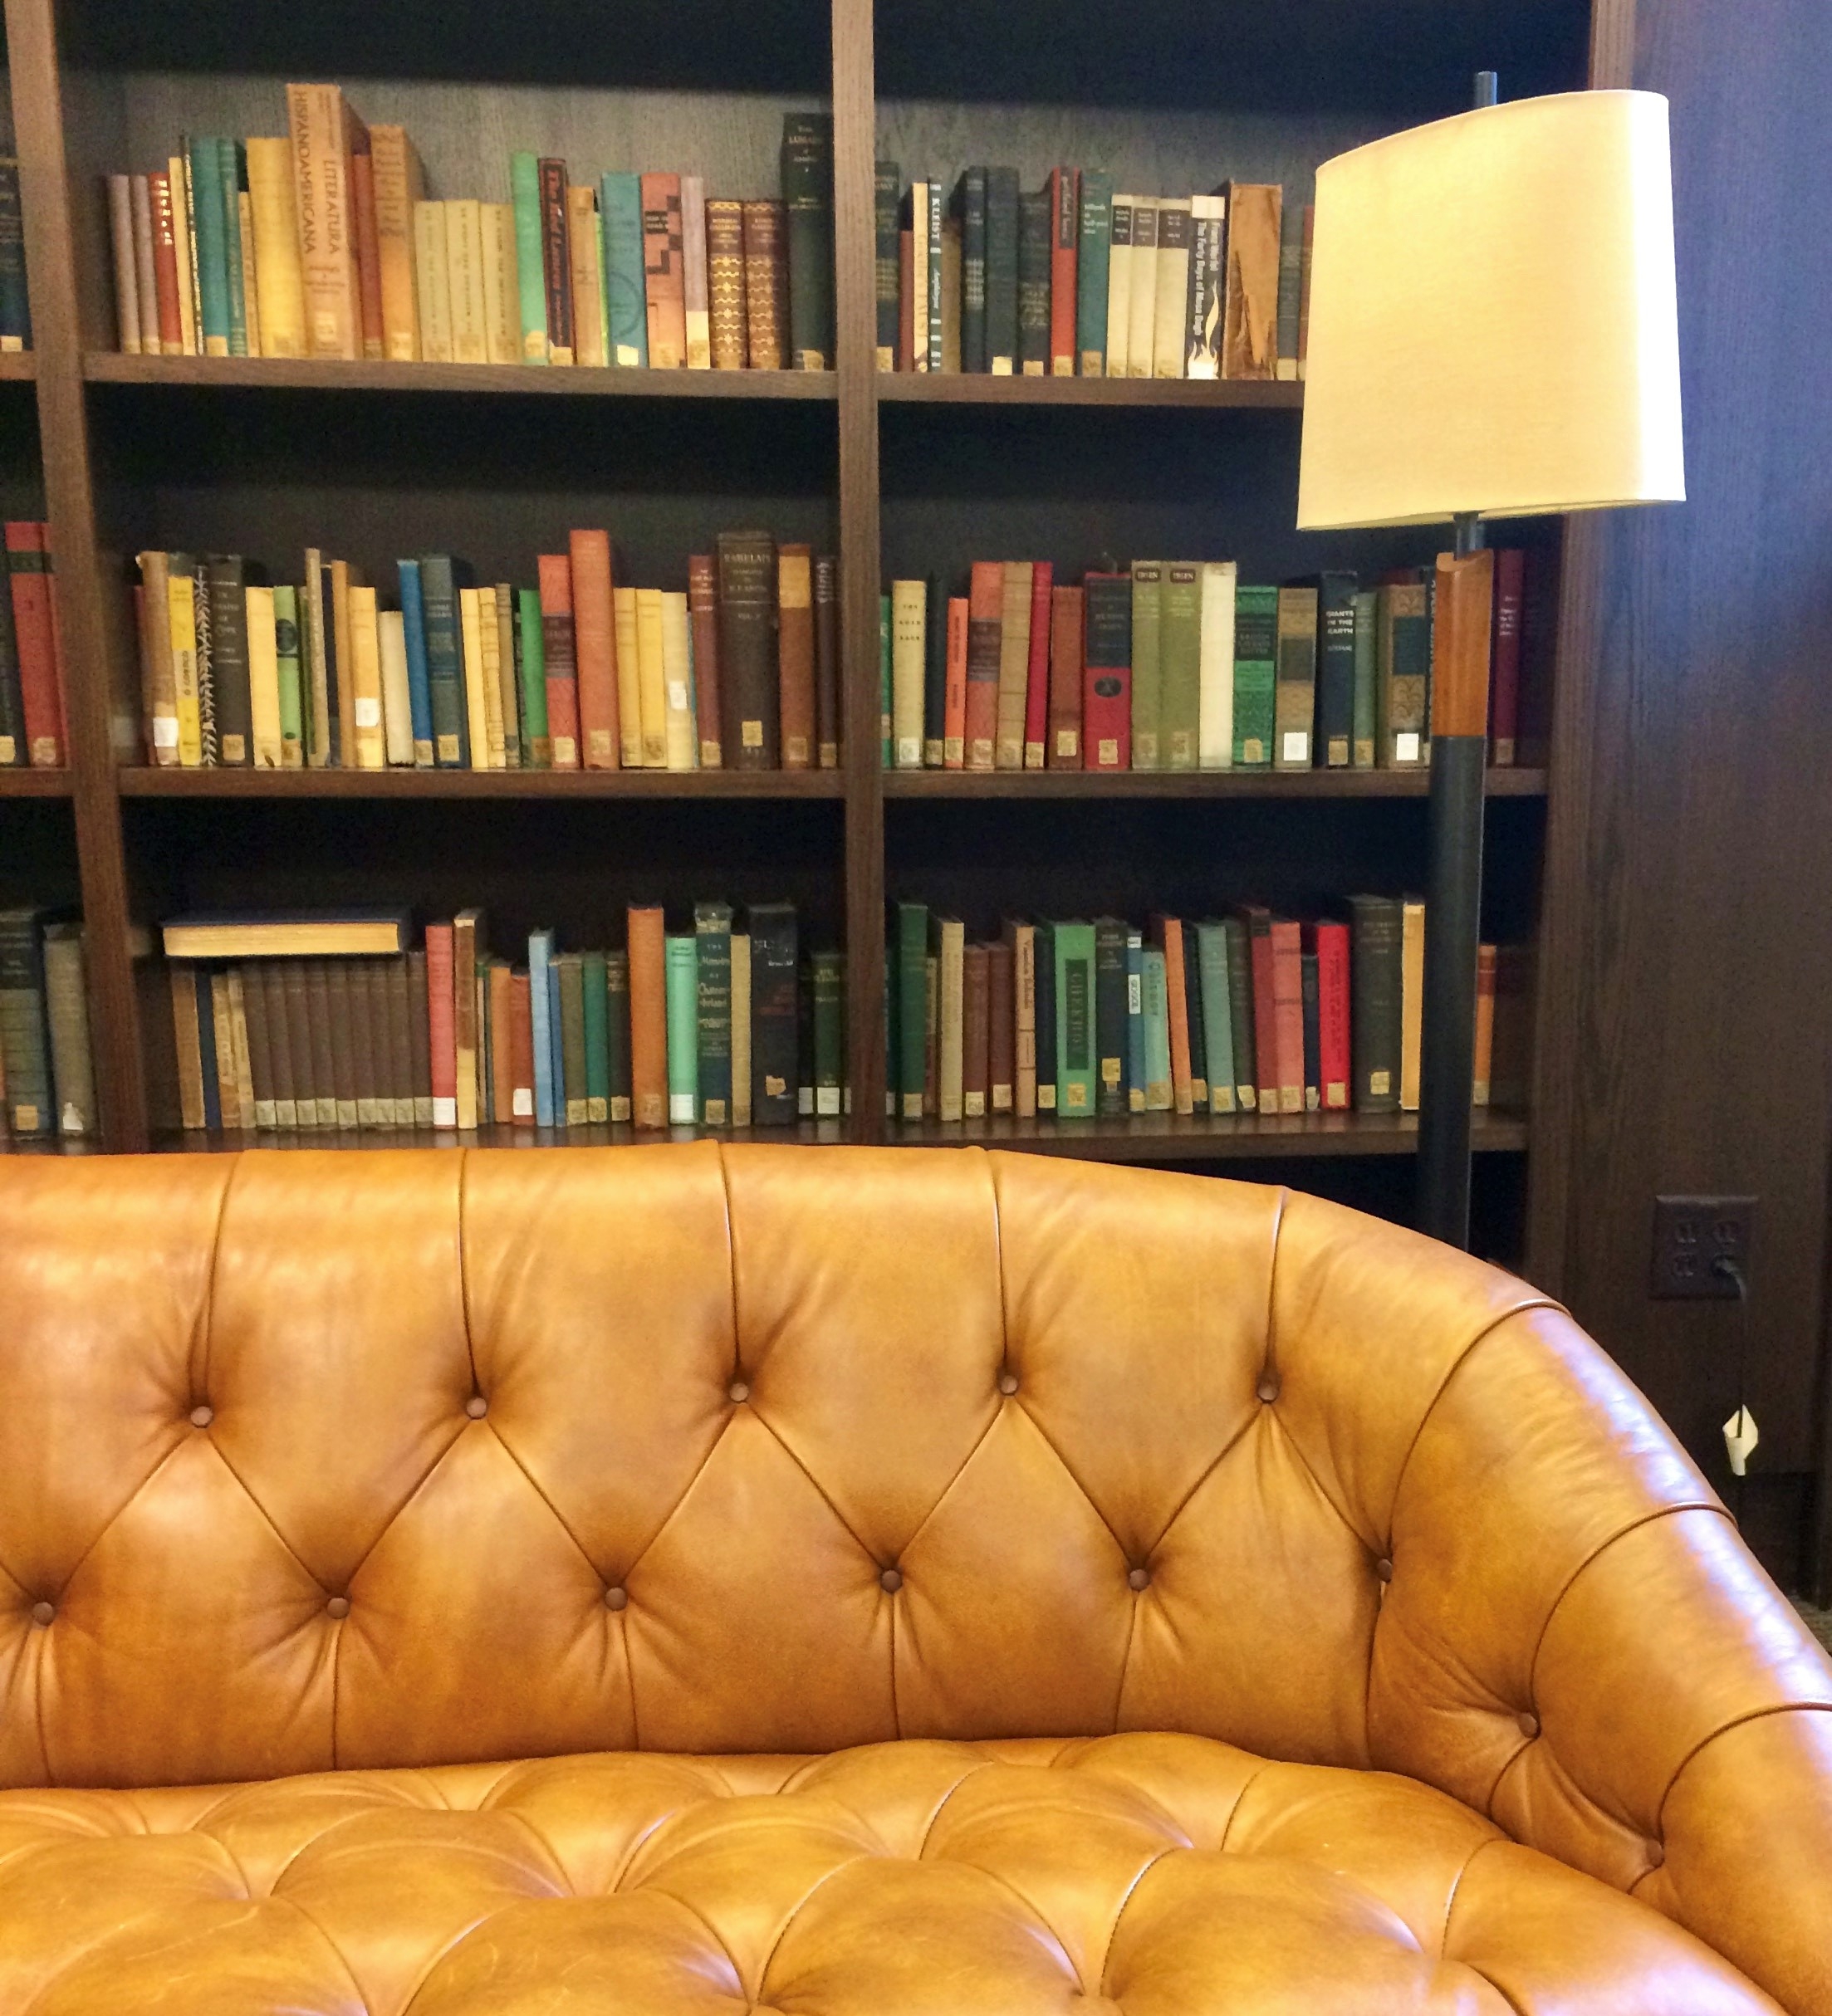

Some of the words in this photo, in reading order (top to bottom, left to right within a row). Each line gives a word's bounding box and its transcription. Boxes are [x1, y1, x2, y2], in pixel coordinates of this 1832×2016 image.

[293, 91, 316, 254] HISPANOAMERICANA
[323, 160, 340, 254] LITERATURA
[931, 198, 941, 240] KLEIST
[1197, 222, 1207, 237] The
[1196, 237, 1207, 260] Forty
[1195, 261, 1206, 281] Days
[724, 554, 771, 563] RABELAIS
[1130, 979, 1139, 1009] GOGOL
[1072, 972, 1084, 1053] CHEKHOV
